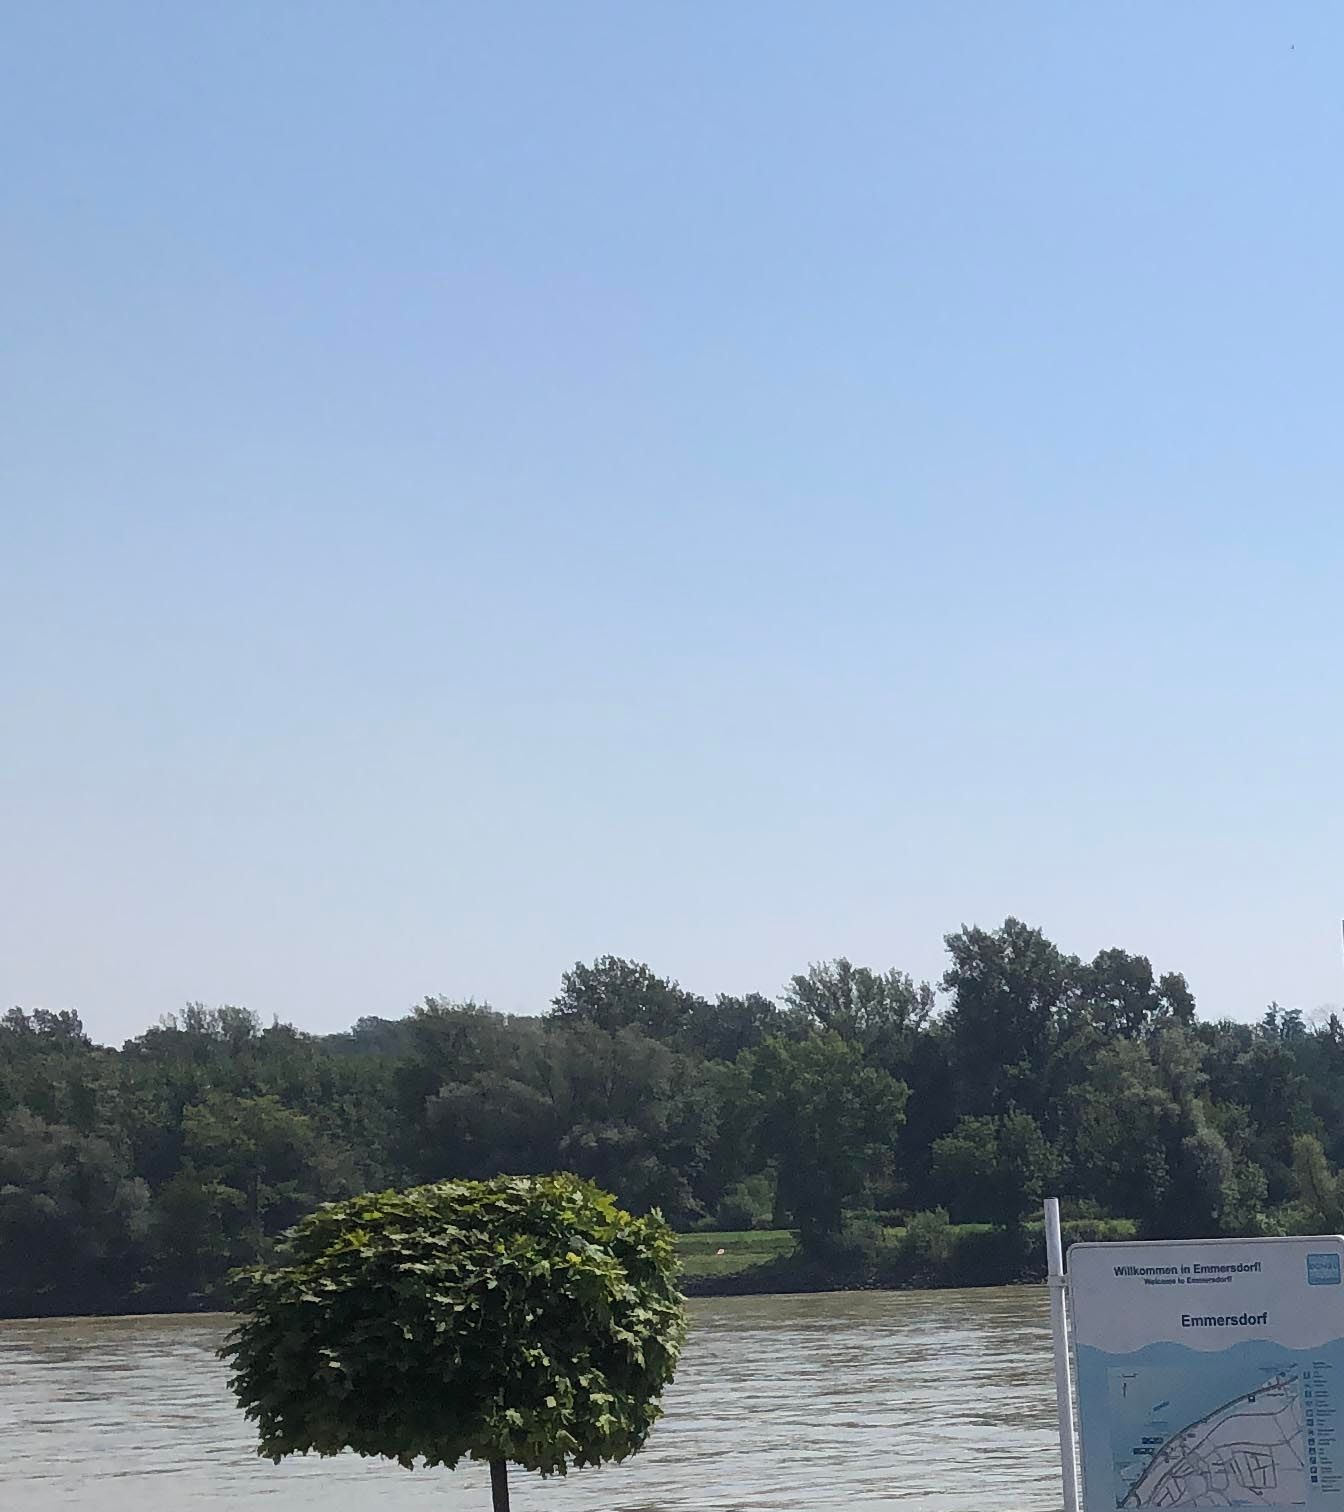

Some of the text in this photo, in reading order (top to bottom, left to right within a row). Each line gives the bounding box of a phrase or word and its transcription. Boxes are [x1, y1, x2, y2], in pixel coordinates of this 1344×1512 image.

[1113, 1261, 1262, 1277] Willkommen in Emmersdorf!
[1181, 1311, 1268, 1328] Emmersdorf
